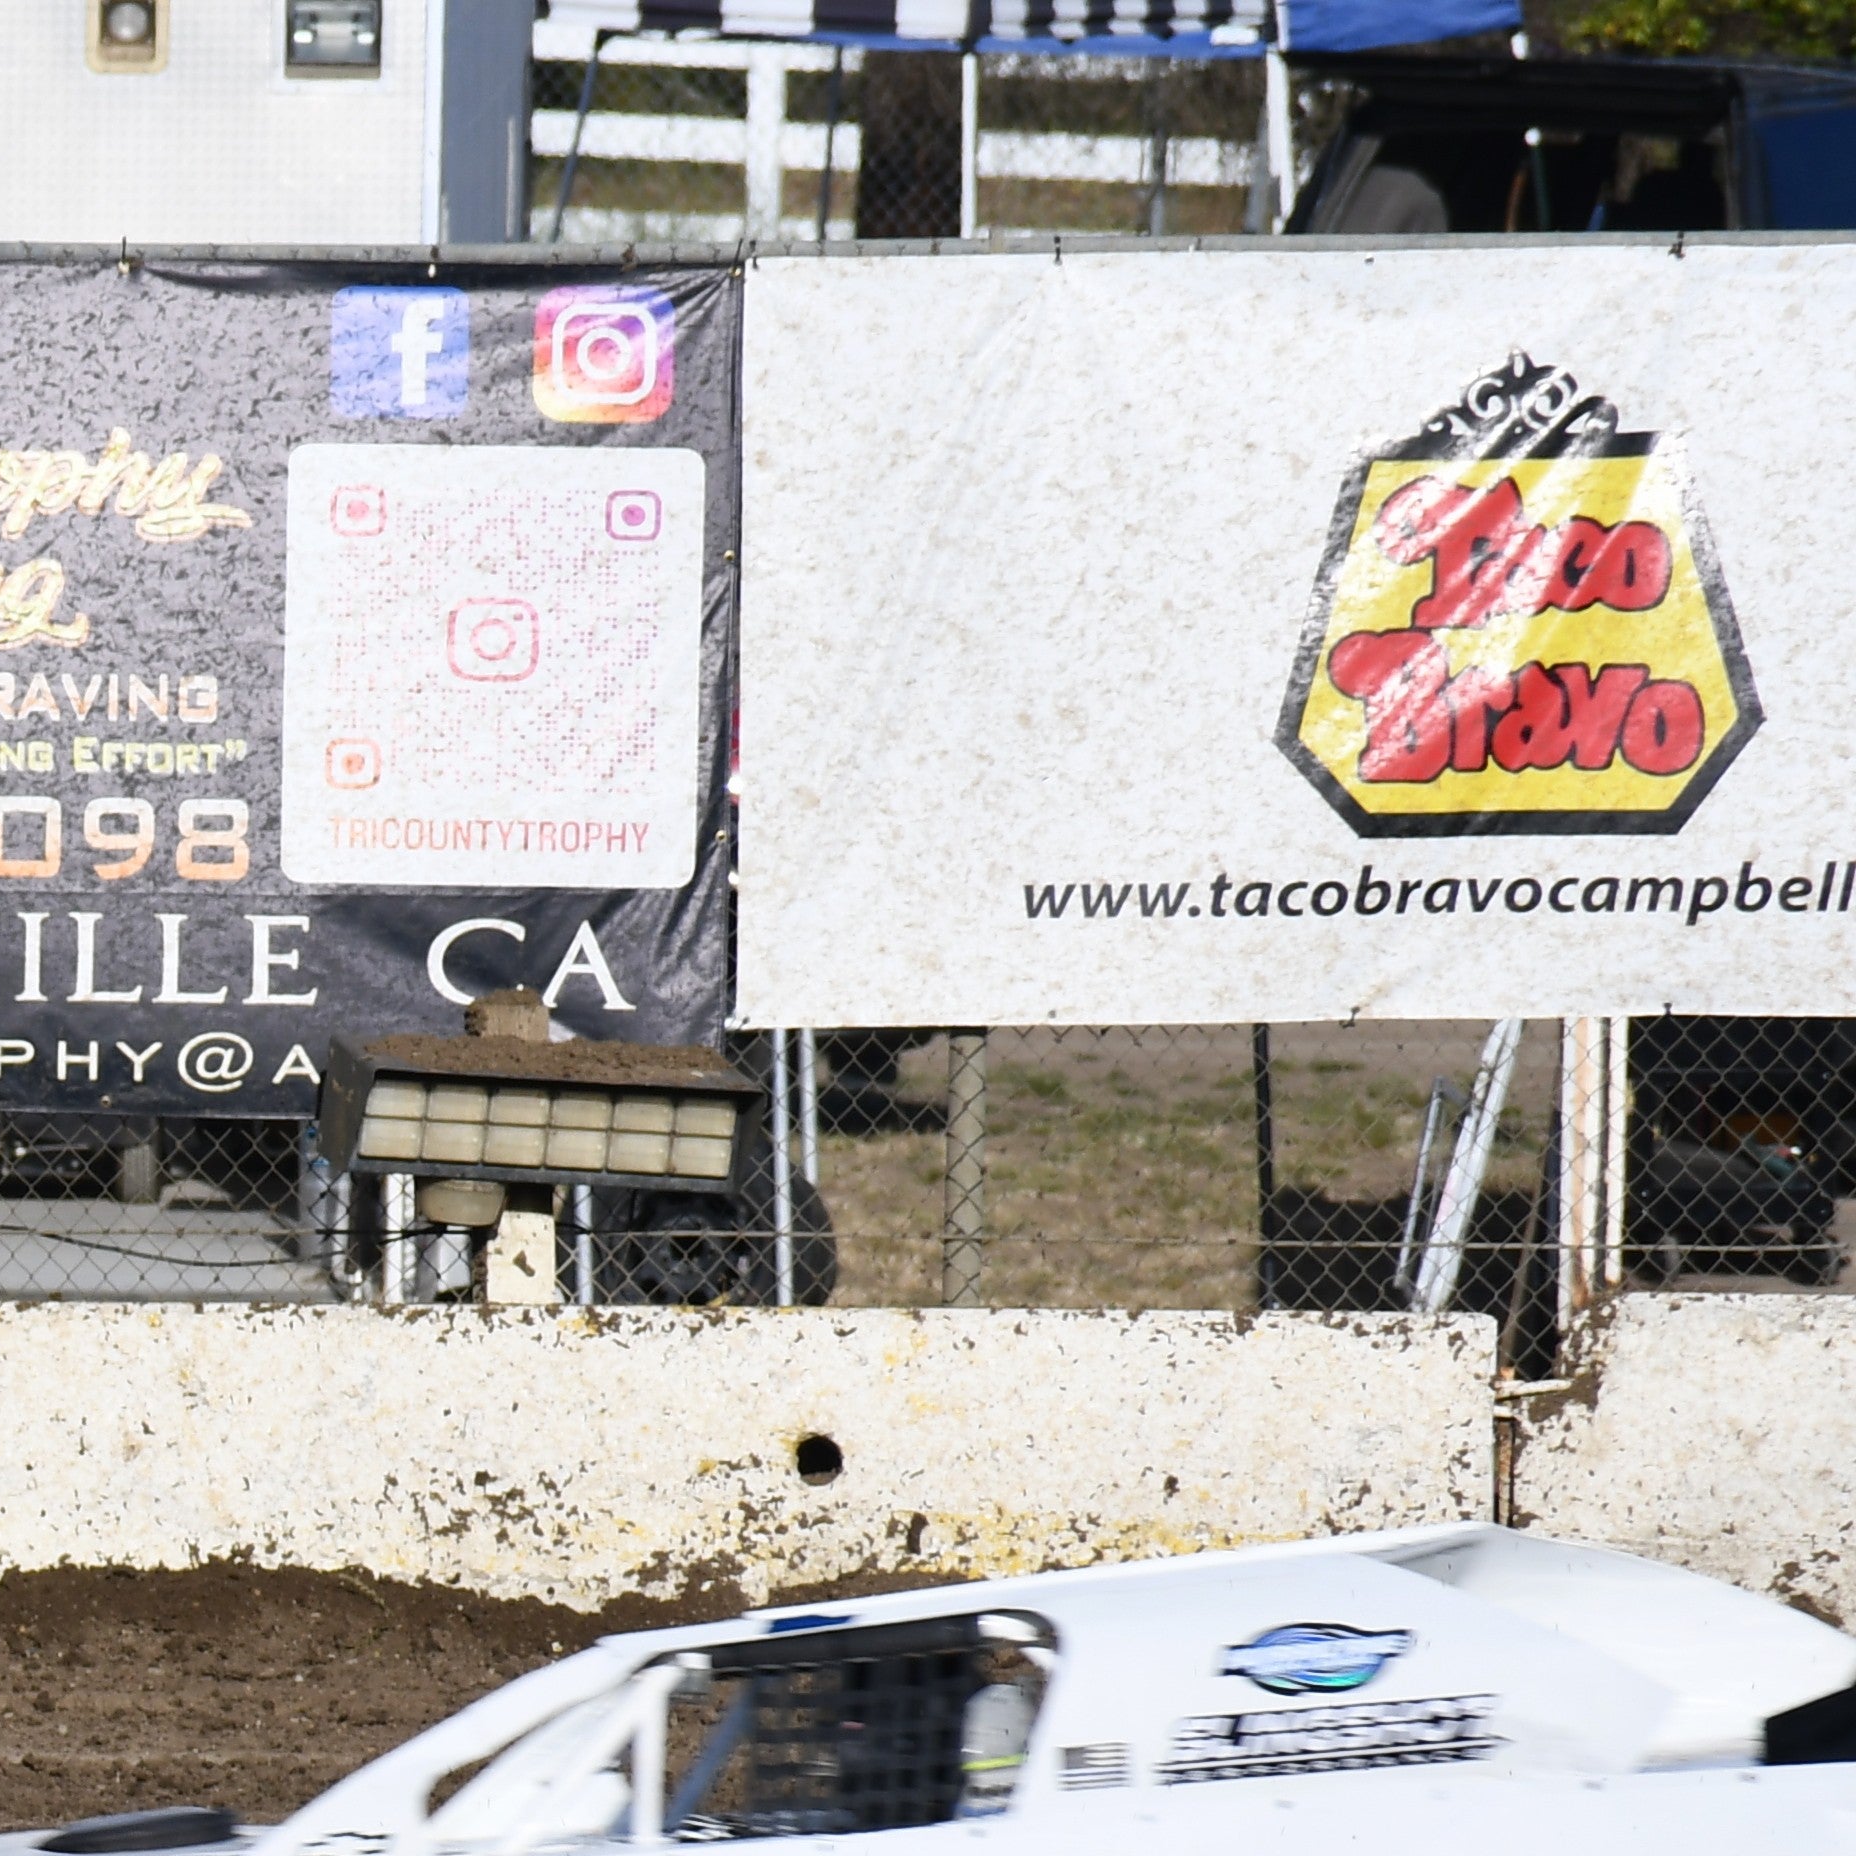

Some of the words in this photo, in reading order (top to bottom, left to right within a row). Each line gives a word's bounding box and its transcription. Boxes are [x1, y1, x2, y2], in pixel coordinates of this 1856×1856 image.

[329, 816, 651, 856] TRICOUNTYTROPHY
[1023, 861, 1856, 926] www.tacobravocampbell
[426, 917, 637, 1014] CA
